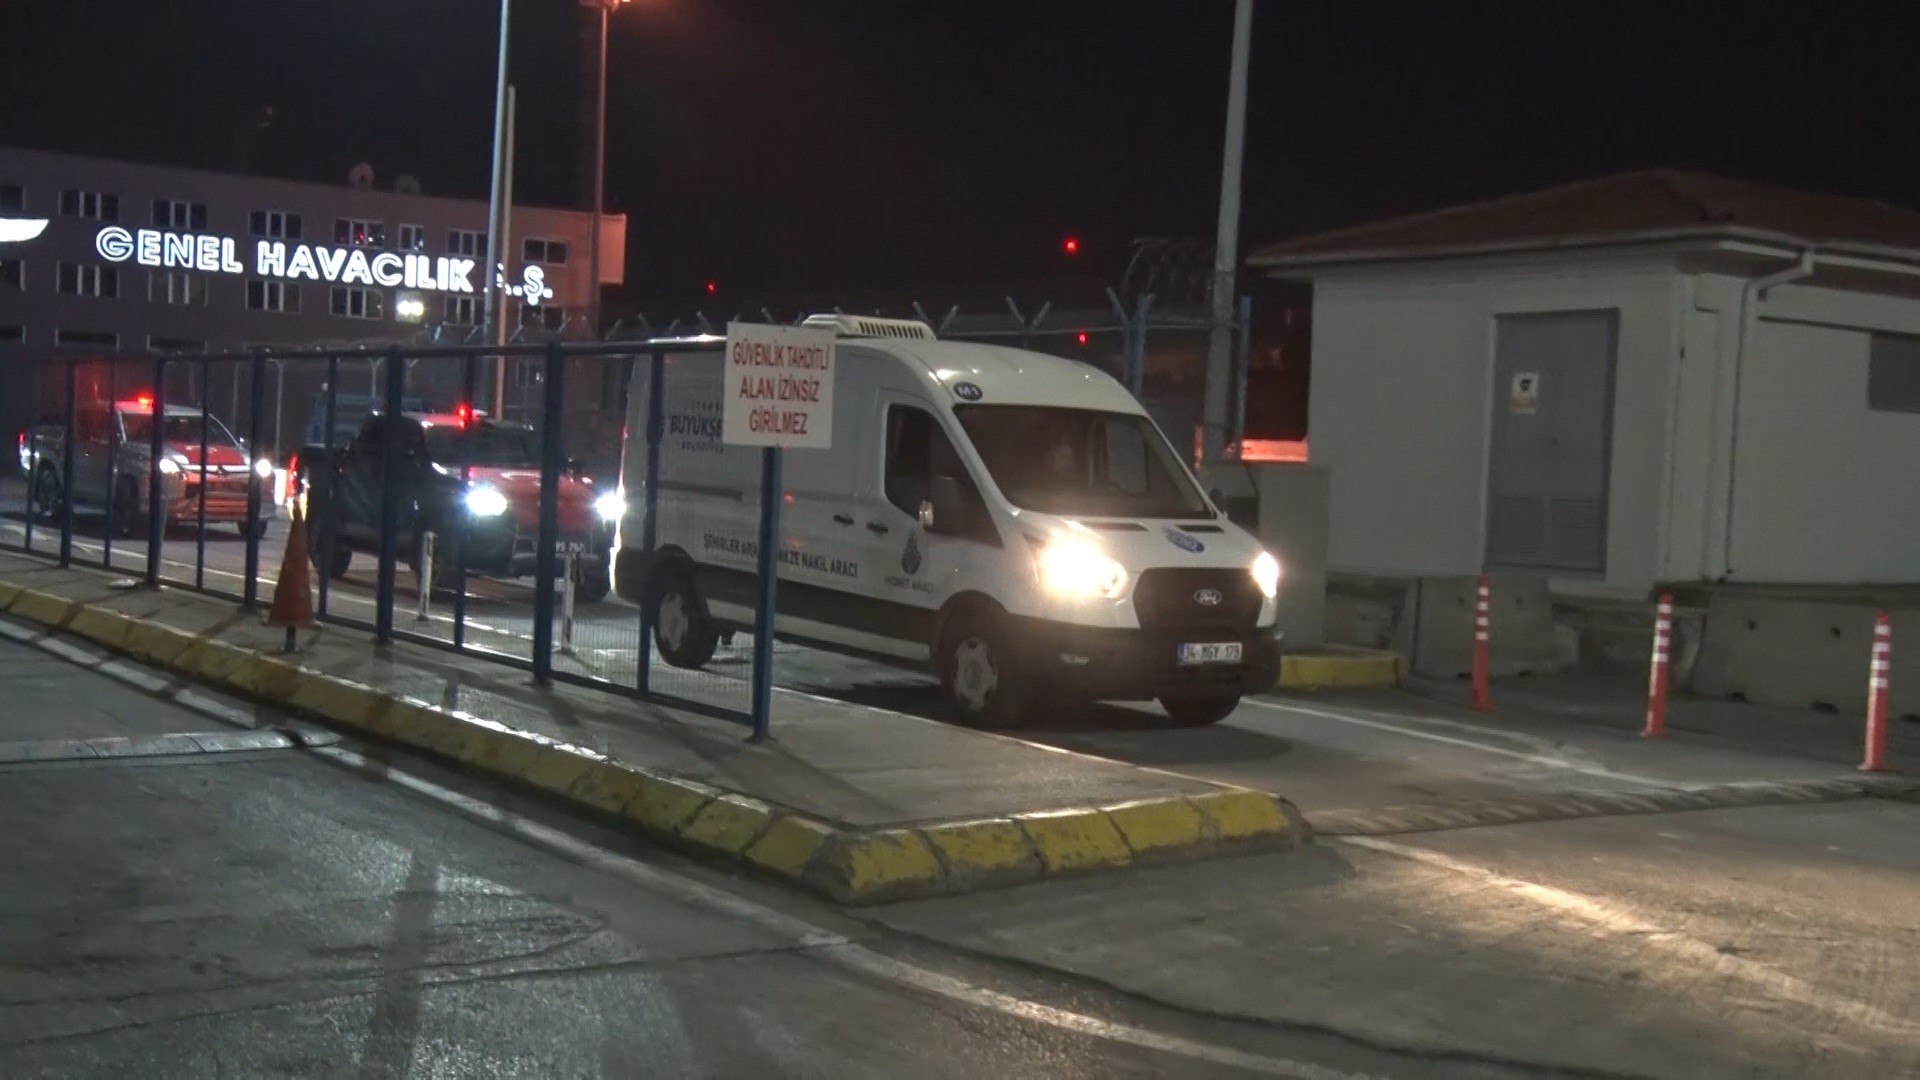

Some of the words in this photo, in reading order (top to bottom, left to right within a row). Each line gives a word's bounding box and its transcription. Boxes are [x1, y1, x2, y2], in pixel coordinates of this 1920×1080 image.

[96, 226, 243, 274] GENEL
[257, 241, 475, 293] HAVACILIK
[733, 338, 785, 367] GÜVENLİK
[739, 376, 775, 400] ALAN
[777, 373, 820, 403] İZİNSİZ
[749, 405, 808, 434] GİRİLMEZ
[830, 558, 858, 578] ARACI
